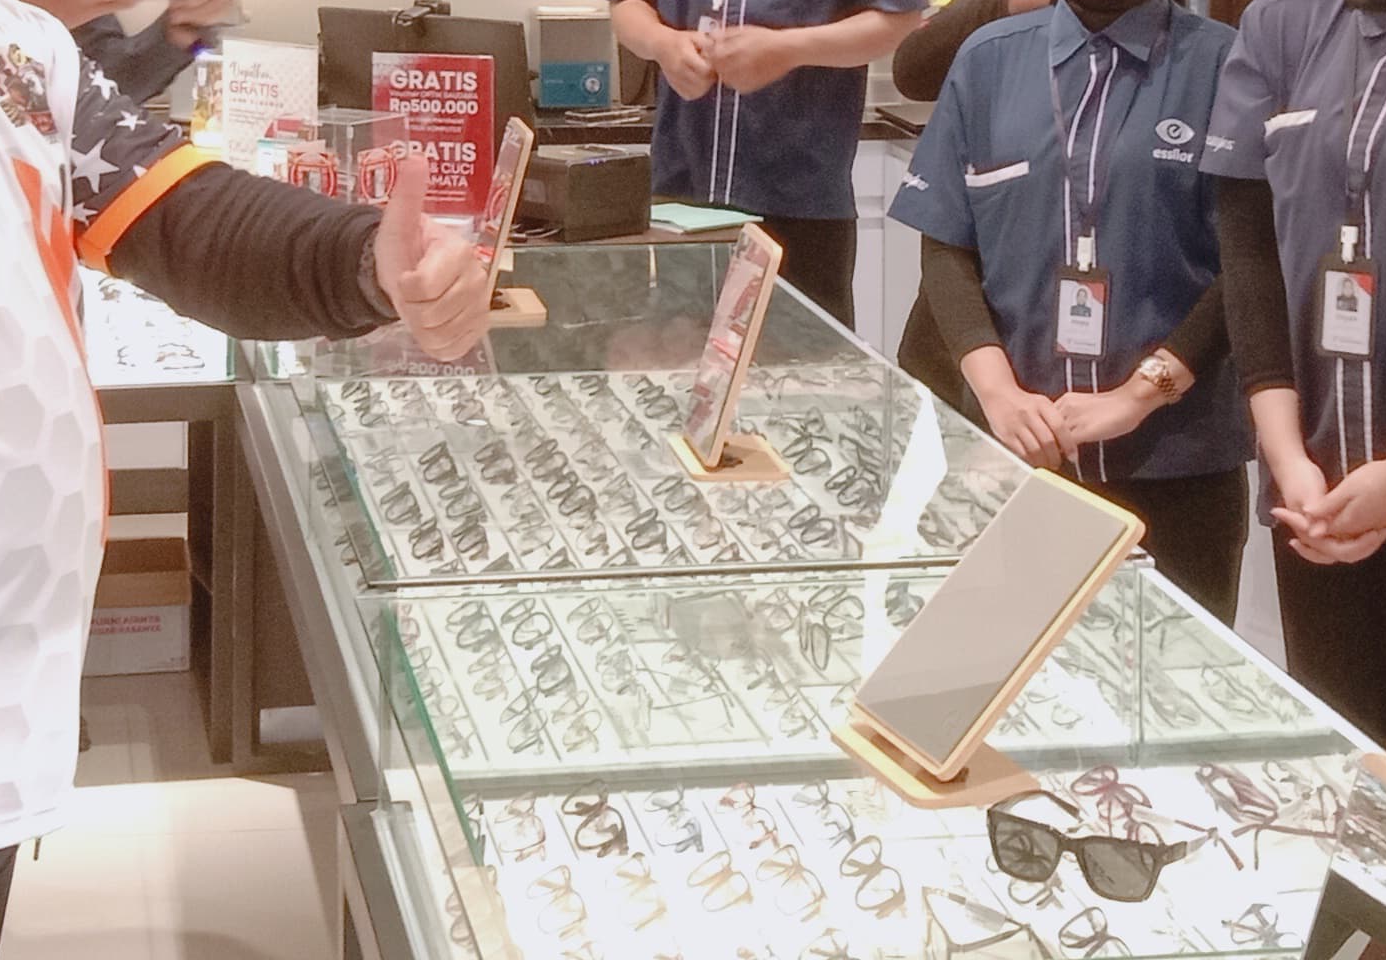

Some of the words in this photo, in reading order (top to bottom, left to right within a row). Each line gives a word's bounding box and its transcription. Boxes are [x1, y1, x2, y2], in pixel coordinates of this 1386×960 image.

[389, 69, 478, 92] GRATIS
[229, 80, 279, 99] GRATIS
[389, 98, 479, 115] Rp500.000
[1152, 148, 1194, 164] essilor
[441, 162, 475, 175] CUCI
